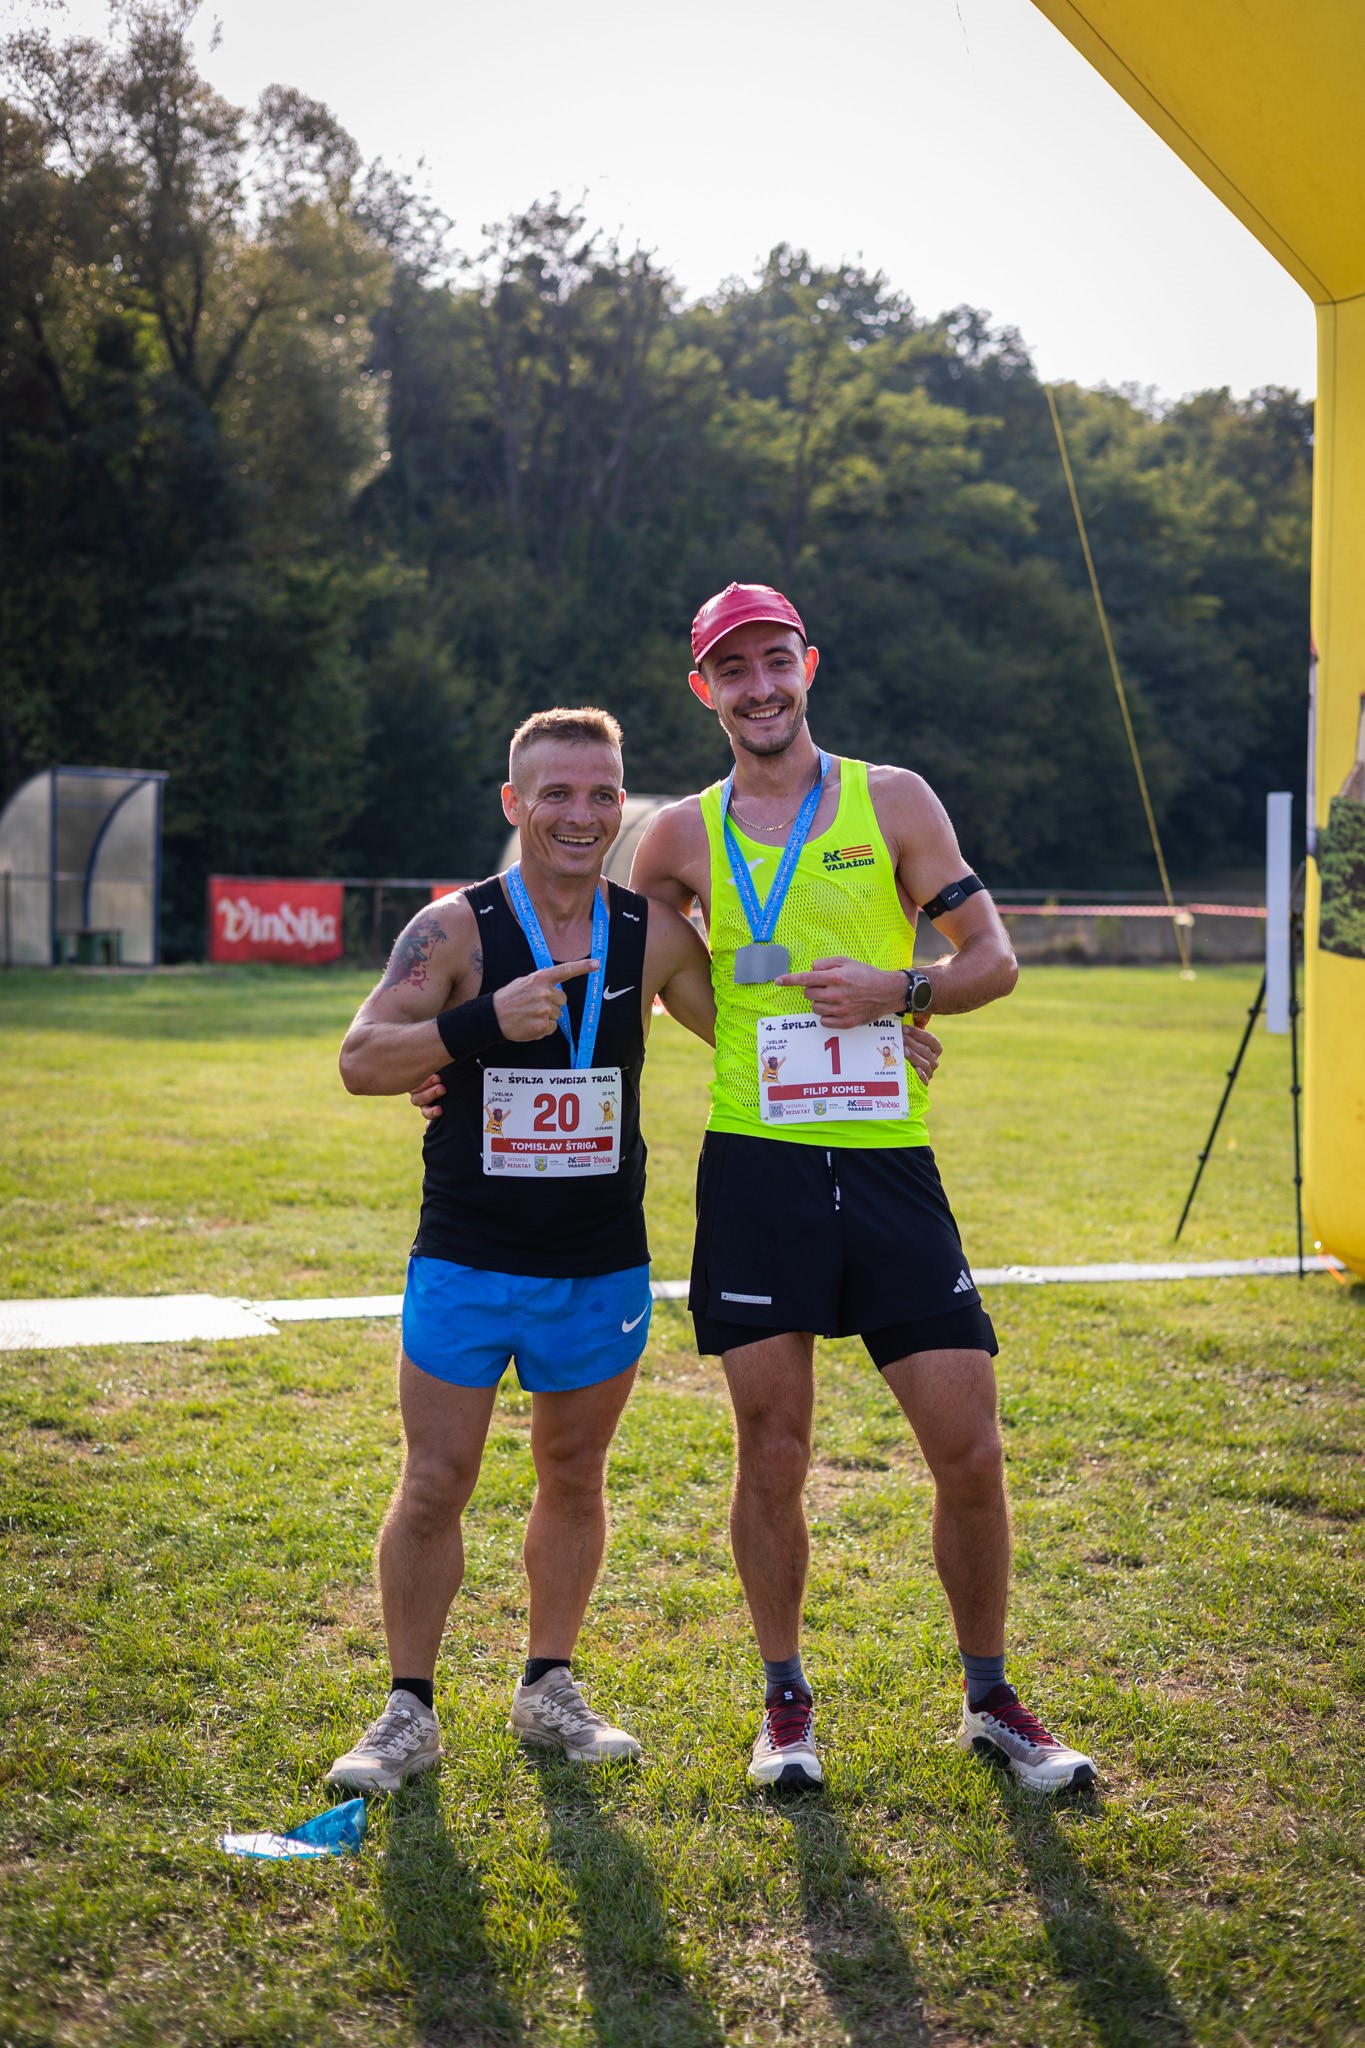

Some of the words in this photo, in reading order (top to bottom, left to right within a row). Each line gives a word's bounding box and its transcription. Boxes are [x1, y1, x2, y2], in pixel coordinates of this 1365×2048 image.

[825, 858, 875, 871] VARAŽDIN
[217, 896, 336, 949] Vindija
[765, 1023, 776, 1032] 4.
[781, 1018, 817, 1031] ŠPILJA
[868, 1019, 895, 1028] RAIL
[824, 1036, 841, 1075] 1
[492, 1075, 503, 1084] 4.
[508, 1072, 544, 1085] ŠPILJA
[549, 1077, 587, 1085] VINDIJA
[591, 1075, 616, 1083] TRAIL
[803, 1087, 829, 1096] FILIP
[831, 1085, 866, 1094] KOMES
[533, 1093, 580, 1132] 20
[511, 1142, 562, 1151] TOMISLAV
[565, 1141, 597, 1151] ŠTRIGA
